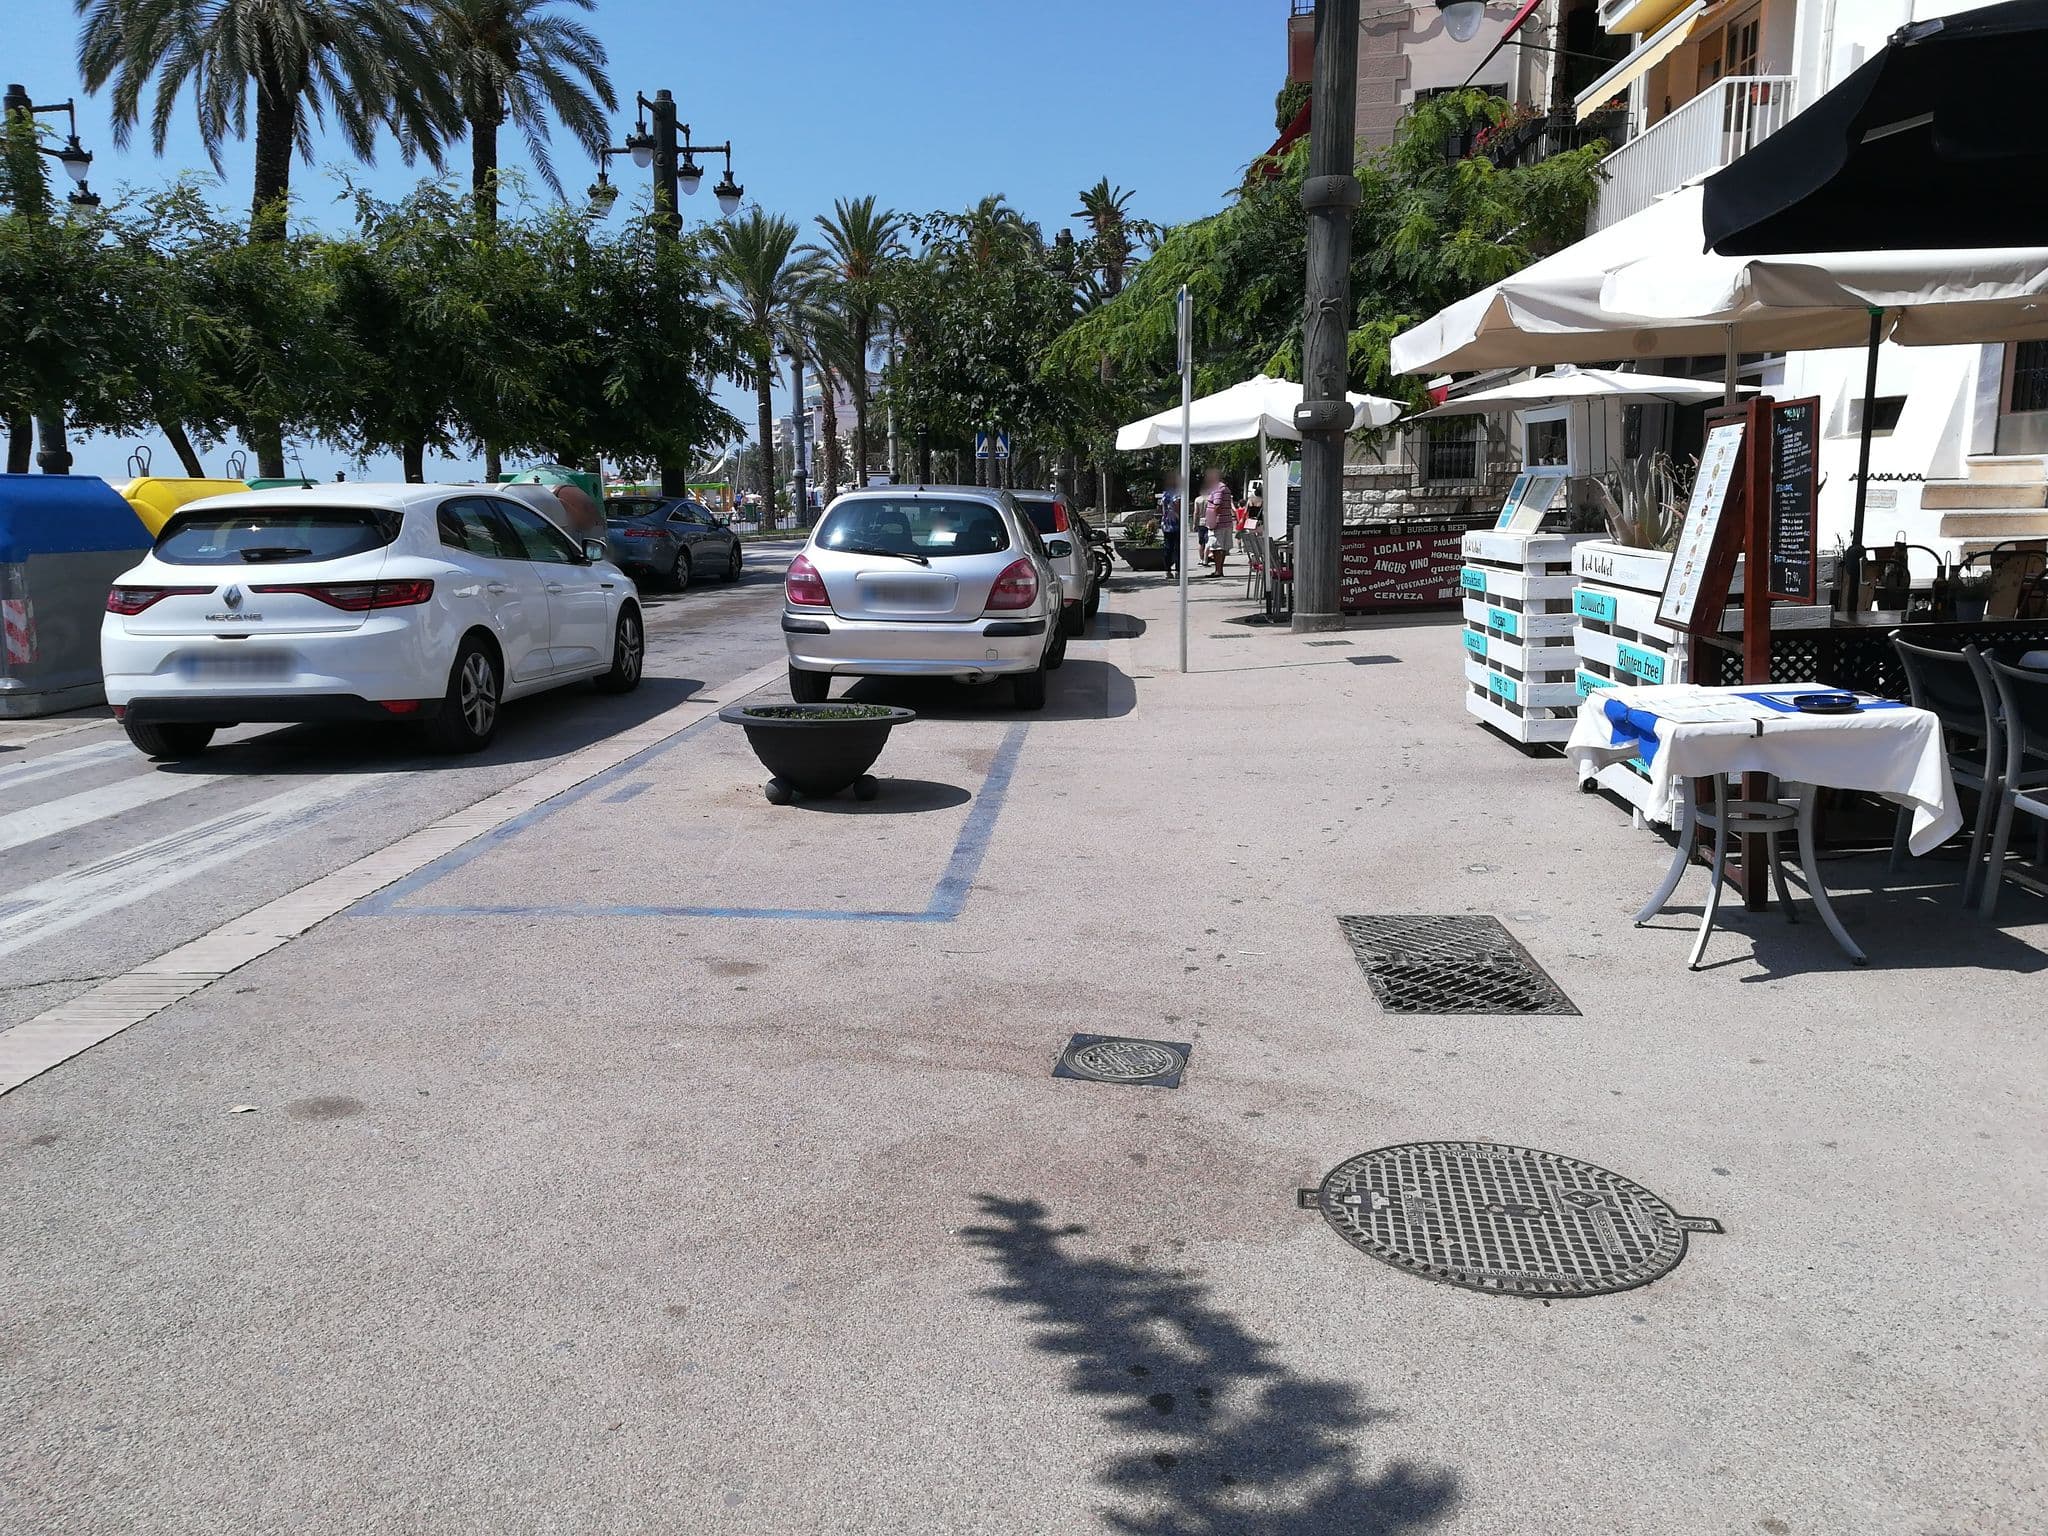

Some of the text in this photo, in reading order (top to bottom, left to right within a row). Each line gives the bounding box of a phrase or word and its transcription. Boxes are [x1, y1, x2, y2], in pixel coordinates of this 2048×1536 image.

[1407, 525, 1438, 534] BURGER
[1440, 524, 1446, 532] &
[1447, 523, 1468, 532] BEER
[1341, 542, 1366, 551] gunitas
[1373, 540, 1423, 556] LOCAL IPA
[1342, 555, 1369, 563] MOJITO
[1374, 557, 1429, 574] ANGUS VINO
[1349, 579, 1396, 595] Piña colada
[1395, 575, 1444, 591] VEGETARIANA
[1342, 596, 1355, 604] tap
[1374, 592, 1424, 600] CERVEZA
[205, 613, 263, 622] MEGANE
[1467, 634, 1480, 650] Lunch
[1643, 657, 1659, 679] free
